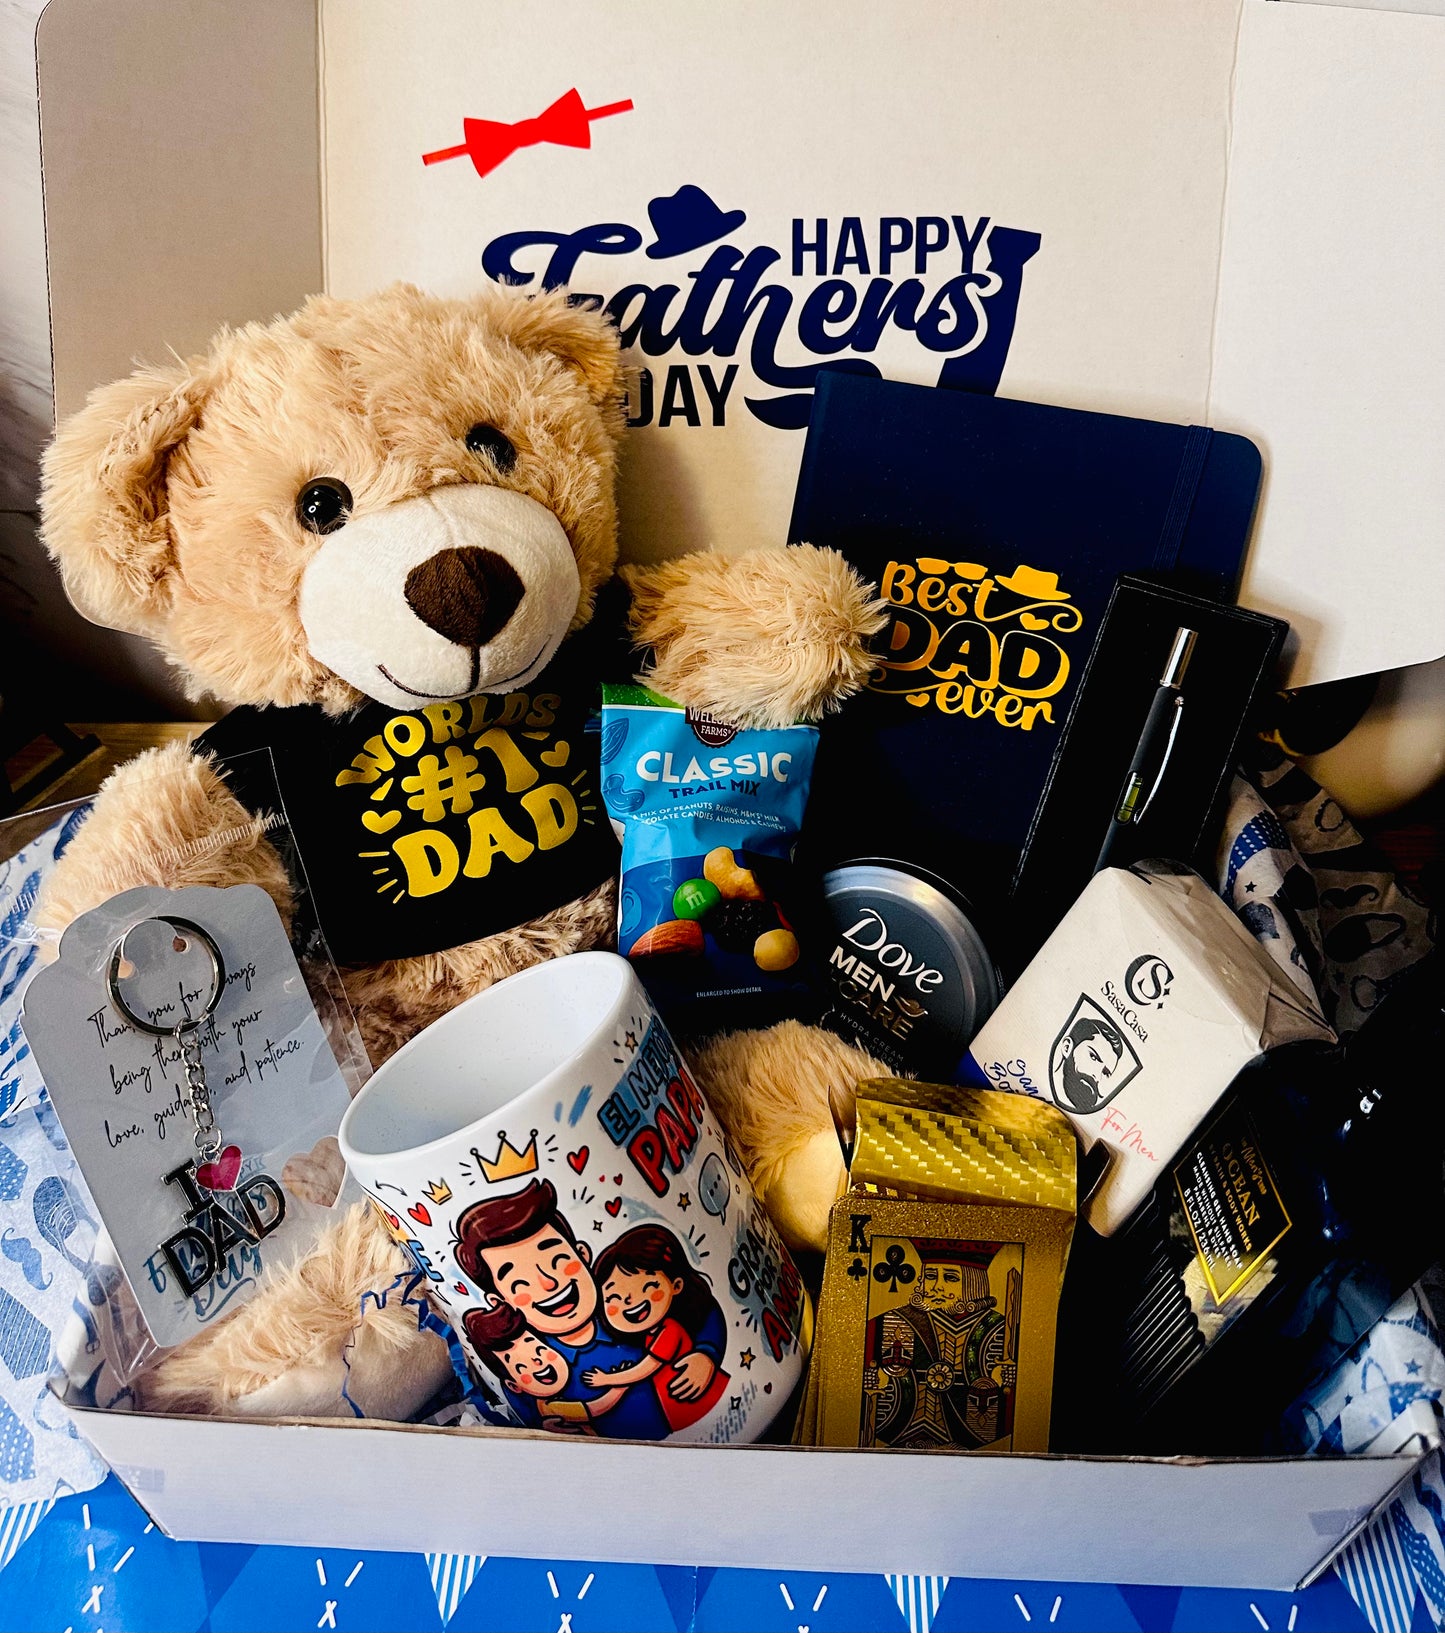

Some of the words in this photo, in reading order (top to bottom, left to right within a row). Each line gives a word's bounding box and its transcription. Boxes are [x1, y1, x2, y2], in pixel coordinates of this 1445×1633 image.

[792, 215, 991, 276] HAPPY
[881, 561, 1000, 622] Best
[869, 604, 1071, 699] DAD
[935, 681, 1056, 731] ever
[335, 692, 561, 787] WORLDS
[636, 751, 792, 784] CLASSIC
[401, 727, 539, 823] #1
[669, 780, 727, 799] TRAIL
[730, 779, 761, 796] MIX
[392, 783, 579, 898] DAD
[716, 815, 749, 825] ALMONDS
[686, 891, 706, 910] m
[829, 945, 896, 1002] MEN
[842, 908, 944, 994] Dove
[147, 1003, 176, 1026] you
[179, 981, 203, 1020] for
[696, 989, 723, 998] ENLARGED
[1100, 980, 1149, 1044] SasaCasa
[109, 1064, 152, 1095] being
[231, 1010, 263, 1046] your
[840, 1013, 870, 1038] HYDRA
[873, 1037, 904, 1062] CREAM
[104, 1119, 145, 1148] love,
[224, 1050, 252, 1084] and
[255, 1038, 305, 1078] patience.
[597, 1092, 640, 1146] EL
[1100, 1106, 1127, 1132] For
[1120, 1123, 1160, 1162] Men
[160, 1157, 216, 1226] I
[1193, 1165, 1203, 1187] MADE
[1201, 1188, 1216, 1225] WITHOUT
[1197, 1152, 1216, 1197] CLEANSING
[1213, 1199, 1224, 1217] GEL
[1219, 1217, 1232, 1243] HAND
[1230, 1244, 1243, 1269] SOAP
[1222, 1143, 1260, 1226] OCEAN
[157, 1173, 287, 1299] DAD
[850, 1214, 873, 1253] K
[1187, 1196, 1196, 1212] FL
[1192, 1211, 1202, 1228] OZ
[1199, 1232, 1210, 1254] 236
[1194, 1187, 1210, 1228] PARABENS
[1211, 1236, 1222, 1258] DYES
[1225, 1190, 1238, 1215] BODY
[1235, 1216, 1252, 1251] WORKS
[754, 1254, 778, 1305] POR
